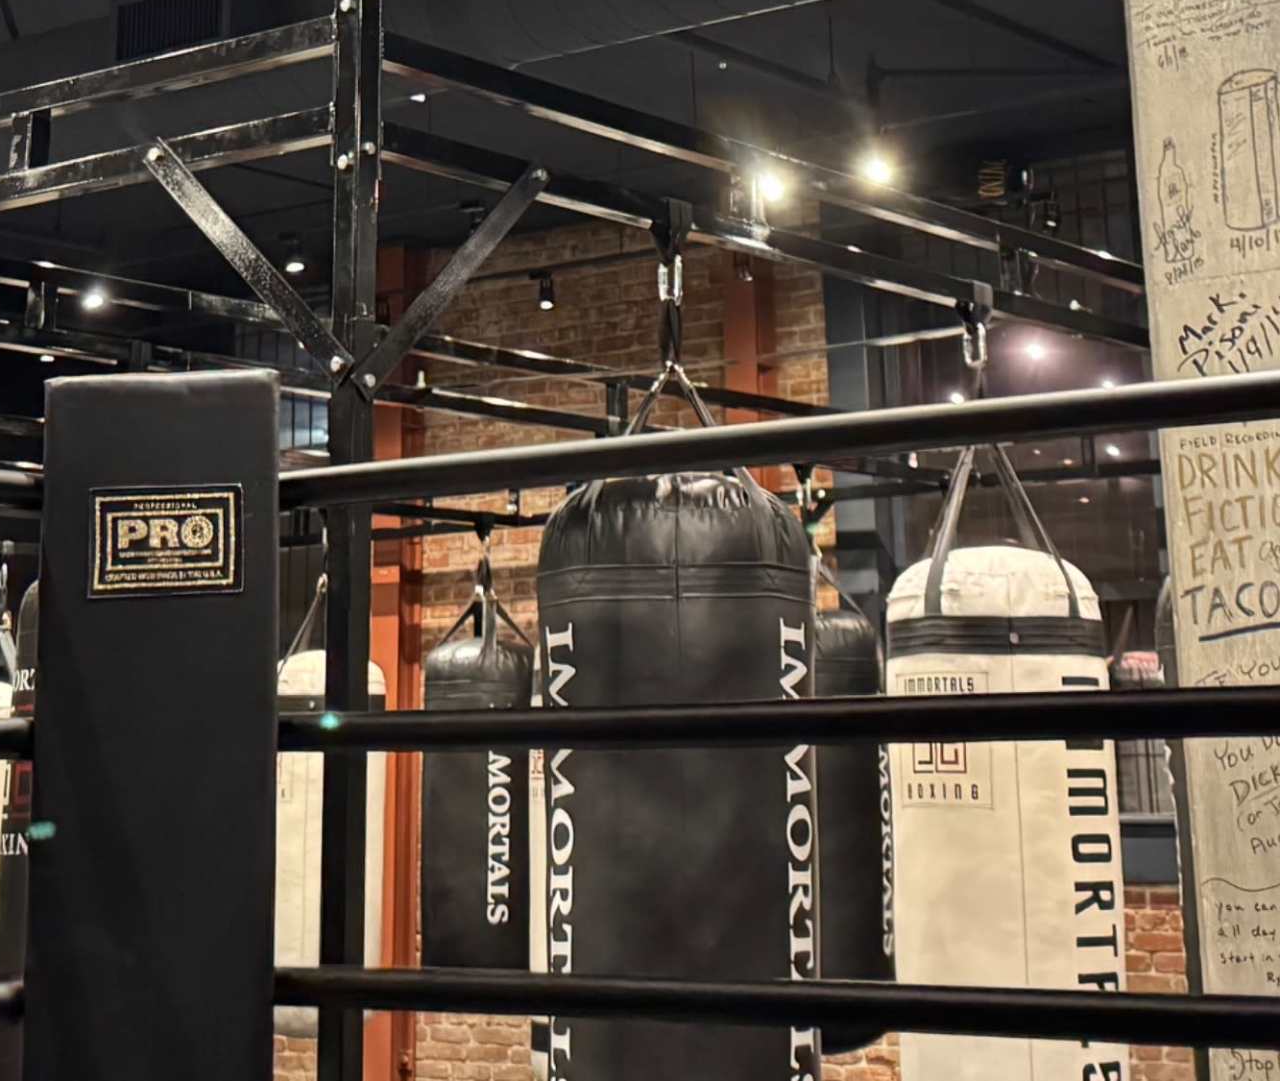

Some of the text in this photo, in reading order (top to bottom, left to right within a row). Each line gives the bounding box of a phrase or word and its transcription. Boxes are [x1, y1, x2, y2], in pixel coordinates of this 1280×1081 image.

[1179, 435, 1218, 450] FIELD
[117, 515, 214, 550] PRO
[1190, 535, 1253, 579] EAT
[903, 676, 975, 694] IMMORTALS
